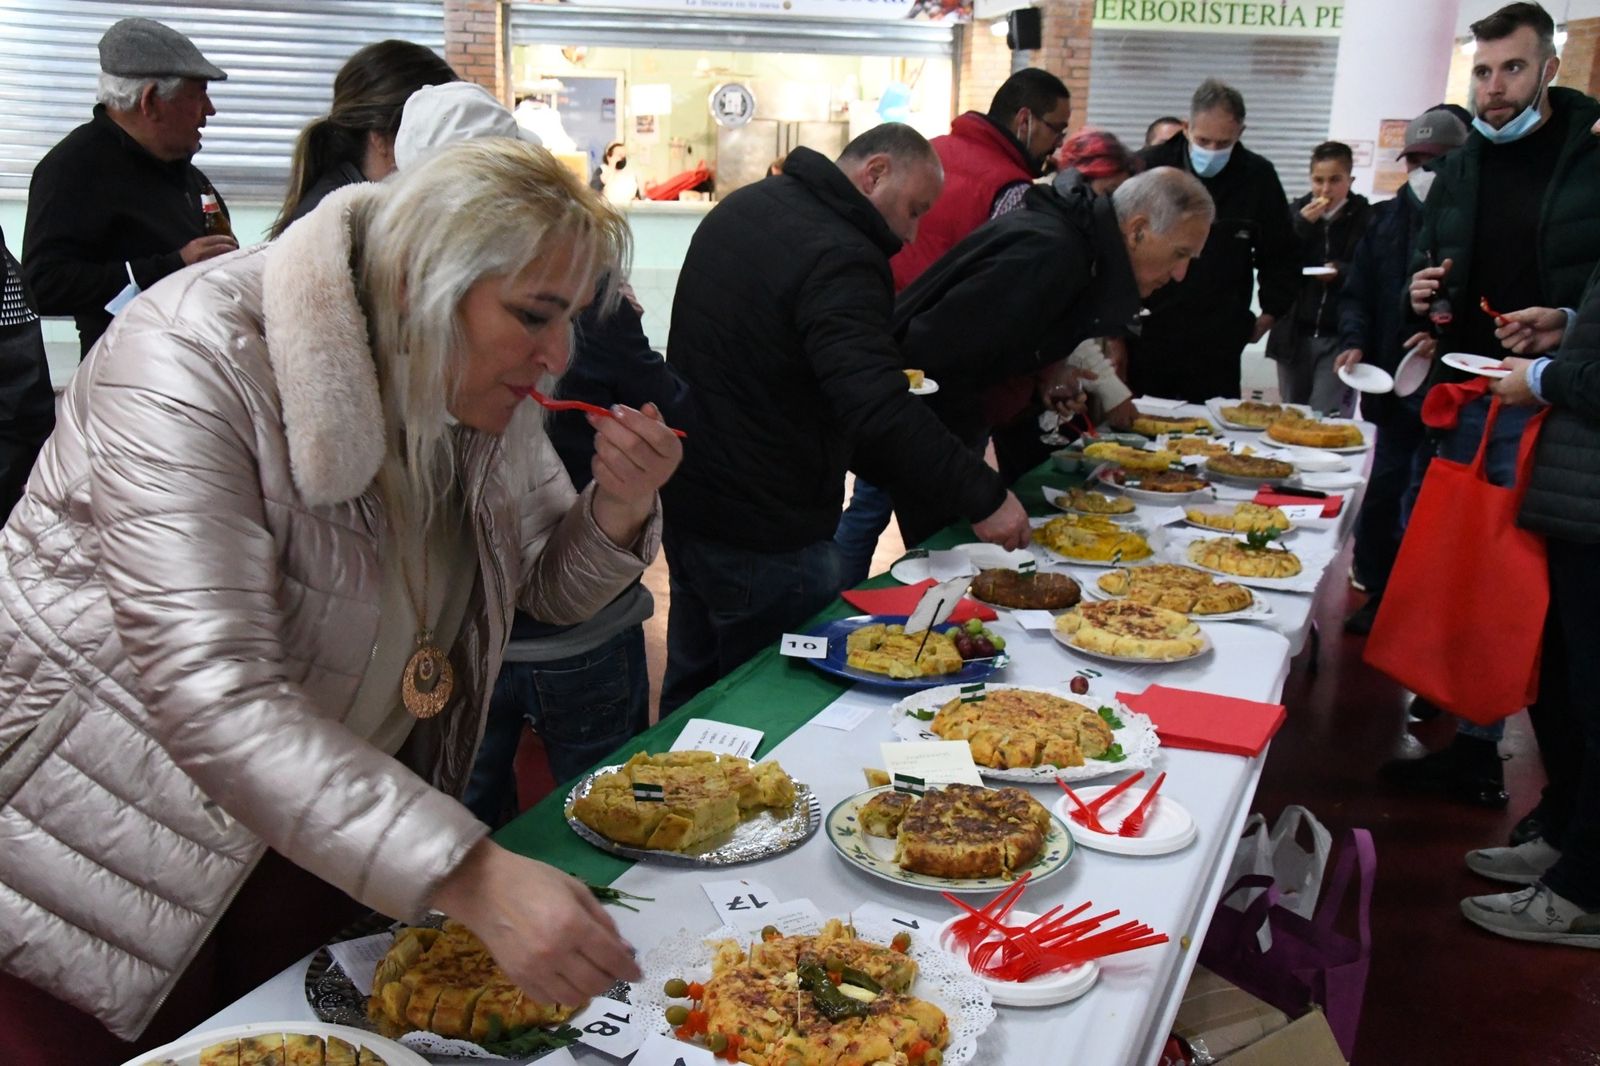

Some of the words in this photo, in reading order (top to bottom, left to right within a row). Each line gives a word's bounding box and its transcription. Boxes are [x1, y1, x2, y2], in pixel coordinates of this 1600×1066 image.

[787, 641, 817, 650] 10
[726, 894, 768, 911] 17
[583, 1012, 631, 1037] 18
